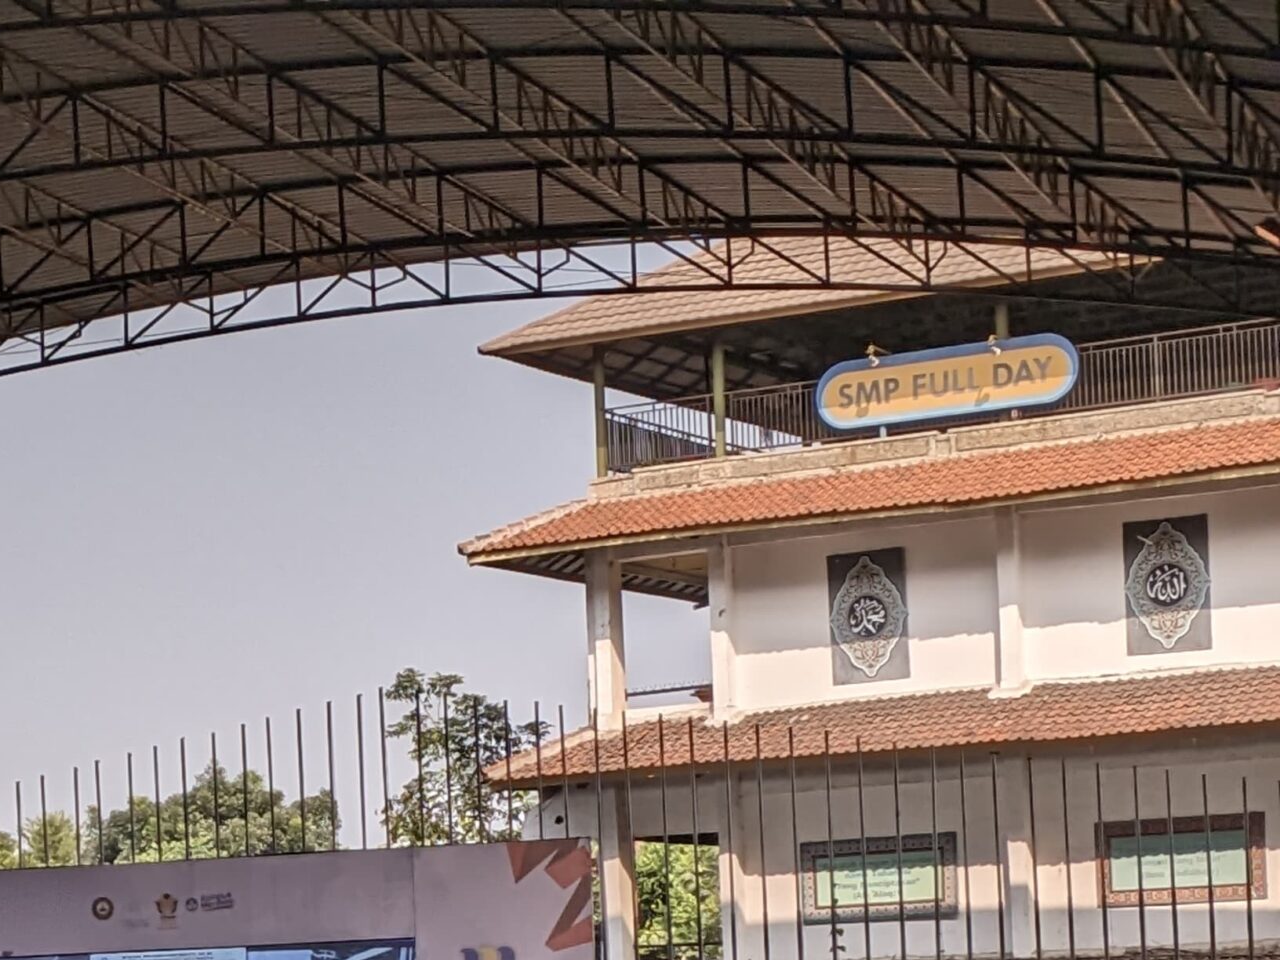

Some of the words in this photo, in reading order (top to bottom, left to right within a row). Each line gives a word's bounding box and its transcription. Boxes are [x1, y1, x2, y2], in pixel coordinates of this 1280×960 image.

[838, 377, 900, 409] SMP
[912, 367, 980, 400] FULL
[992, 355, 1052, 388] DAY
